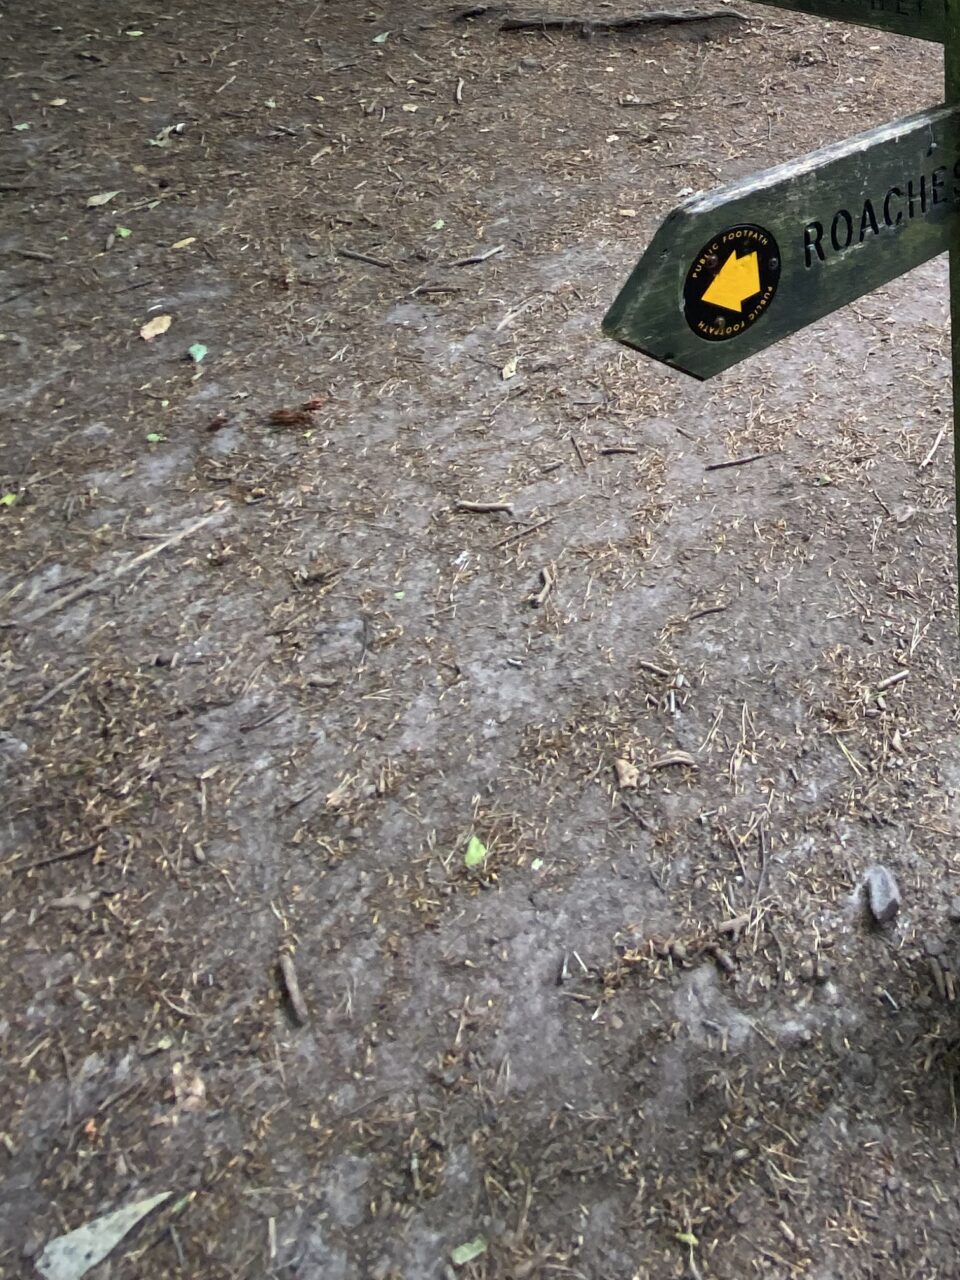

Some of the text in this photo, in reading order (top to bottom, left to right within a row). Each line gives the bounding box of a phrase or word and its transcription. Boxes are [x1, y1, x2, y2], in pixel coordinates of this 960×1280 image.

[692, 229, 769, 279] PUBLIC FOOTPATH
[697, 286, 774, 336] PUBLIC FOOTPATH
